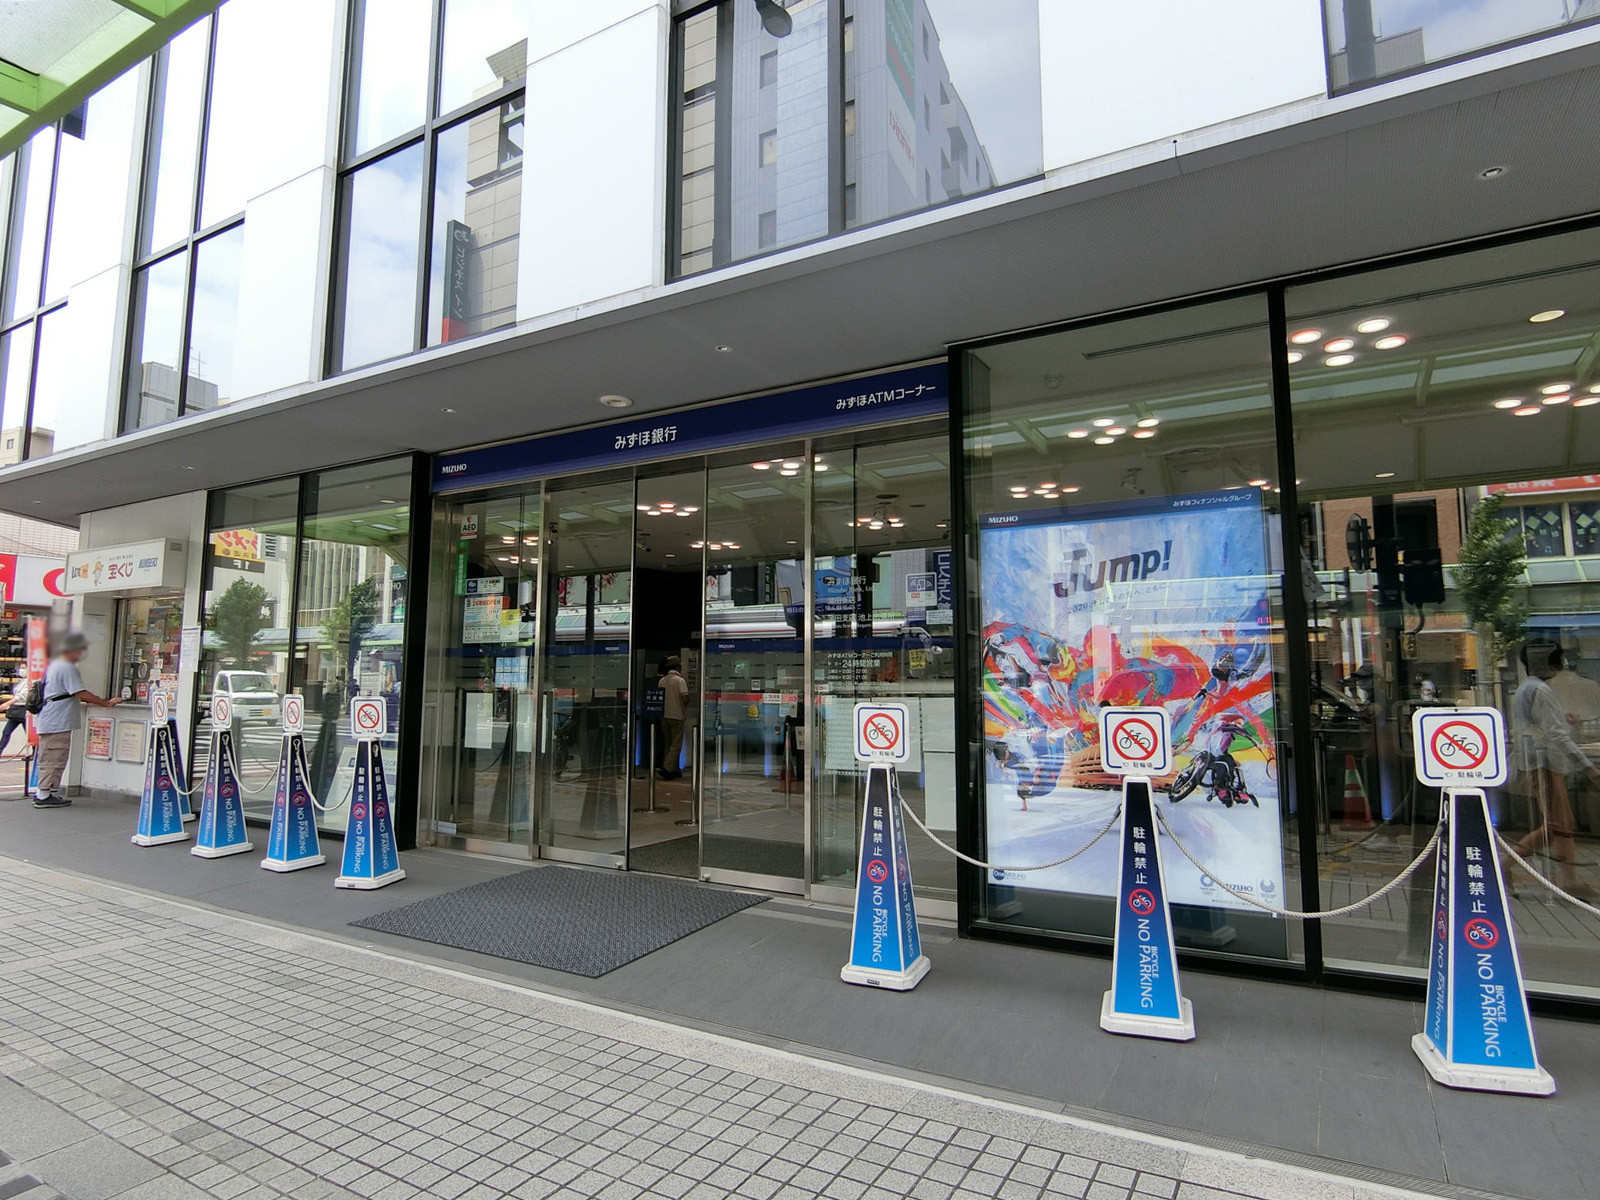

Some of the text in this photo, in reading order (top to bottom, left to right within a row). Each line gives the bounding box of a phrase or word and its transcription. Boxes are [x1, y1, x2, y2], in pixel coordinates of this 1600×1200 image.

[836, 384, 936, 410] みずほATMコーナー
[614, 425, 677, 450] みずほ銀行
[442, 463, 468, 474] MIZUHO
[462, 524, 476, 532] AED
[988, 515, 1018, 524] MIZUHO
[108, 562, 133, 580] 宝くじ
[1053, 540, 1172, 599] Jump!
[378, 818, 386, 832] NO
[872, 806, 884, 858] 駐輪禁止
[353, 821, 362, 874] NO PARKING
[1132, 826, 1148, 886] 駐輪禁止
[1225, 883, 1254, 893] IZUHO
[1466, 846, 1488, 914] 駐輪禁止
[872, 885, 883, 963] NO PARKING
[1137, 918, 1154, 1009] NO PARKING
[1150, 945, 1160, 979] BICYCLE
[1476, 953, 1502, 1058] NO PARKING
[1494, 984, 1507, 1023] BICYCLE
